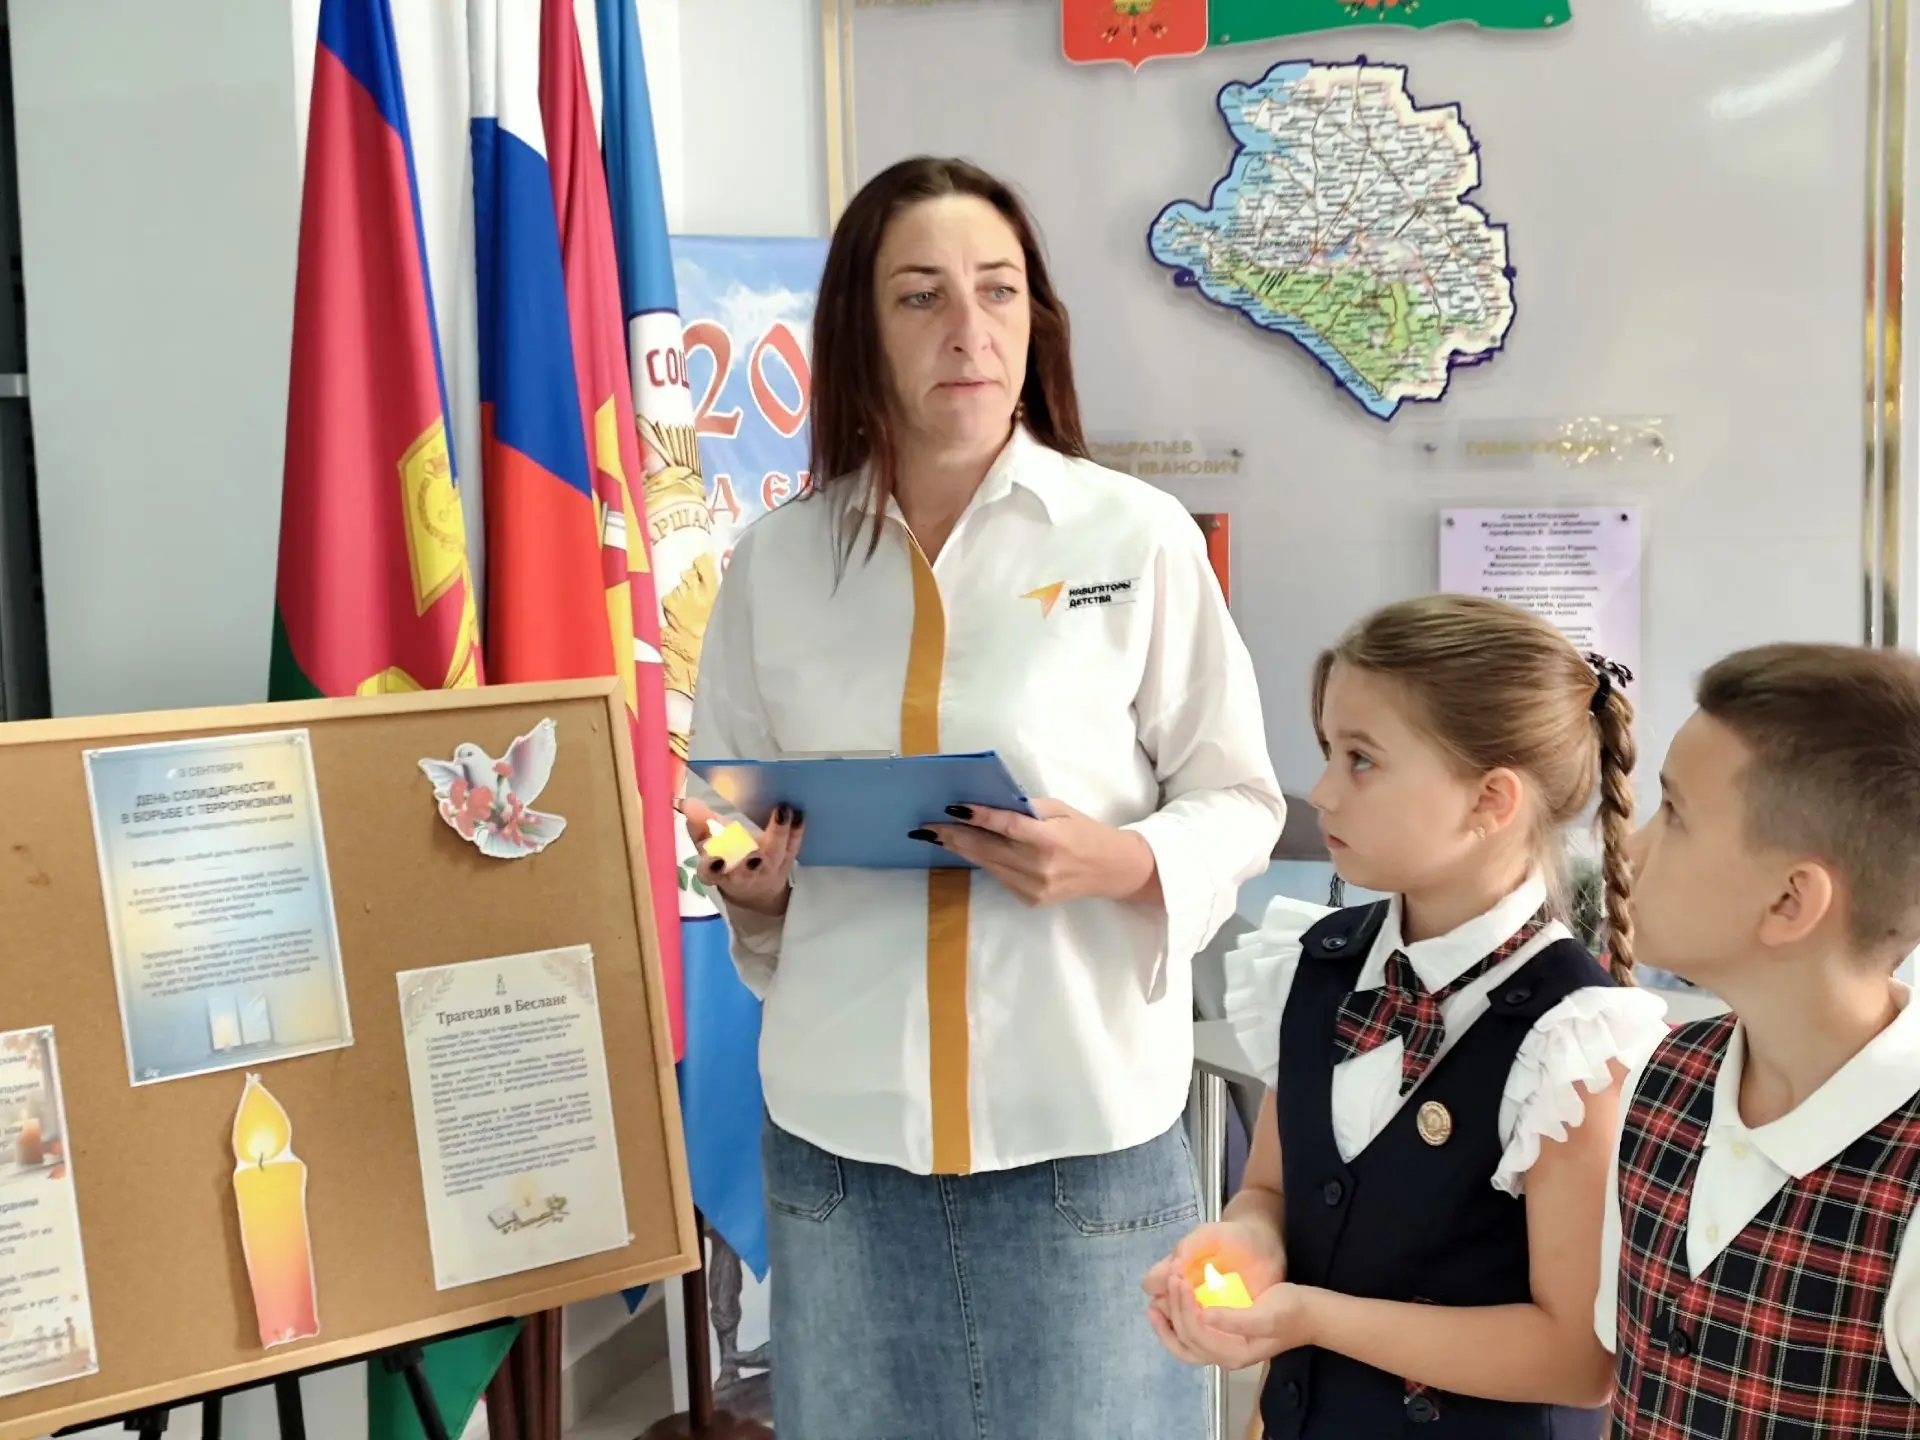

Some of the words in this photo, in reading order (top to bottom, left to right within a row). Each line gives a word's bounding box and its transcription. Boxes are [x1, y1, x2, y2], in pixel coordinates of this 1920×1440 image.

[188, 762, 244, 777] СЕНТЯБРЯ
[136, 793, 171, 808] ДЕНЬ
[172, 781, 276, 803] СОЛИДАРНОСТИ
[121, 813, 130, 824] В
[133, 807, 184, 823] БОРЬБЕ
[186, 806, 195, 816] С
[197, 794, 293, 815] ТЕРРОРИЗМОМ
[436, 1006, 501, 1026] Трагедия
[504, 1004, 512, 1014] в
[515, 994, 568, 1012] Беслане
